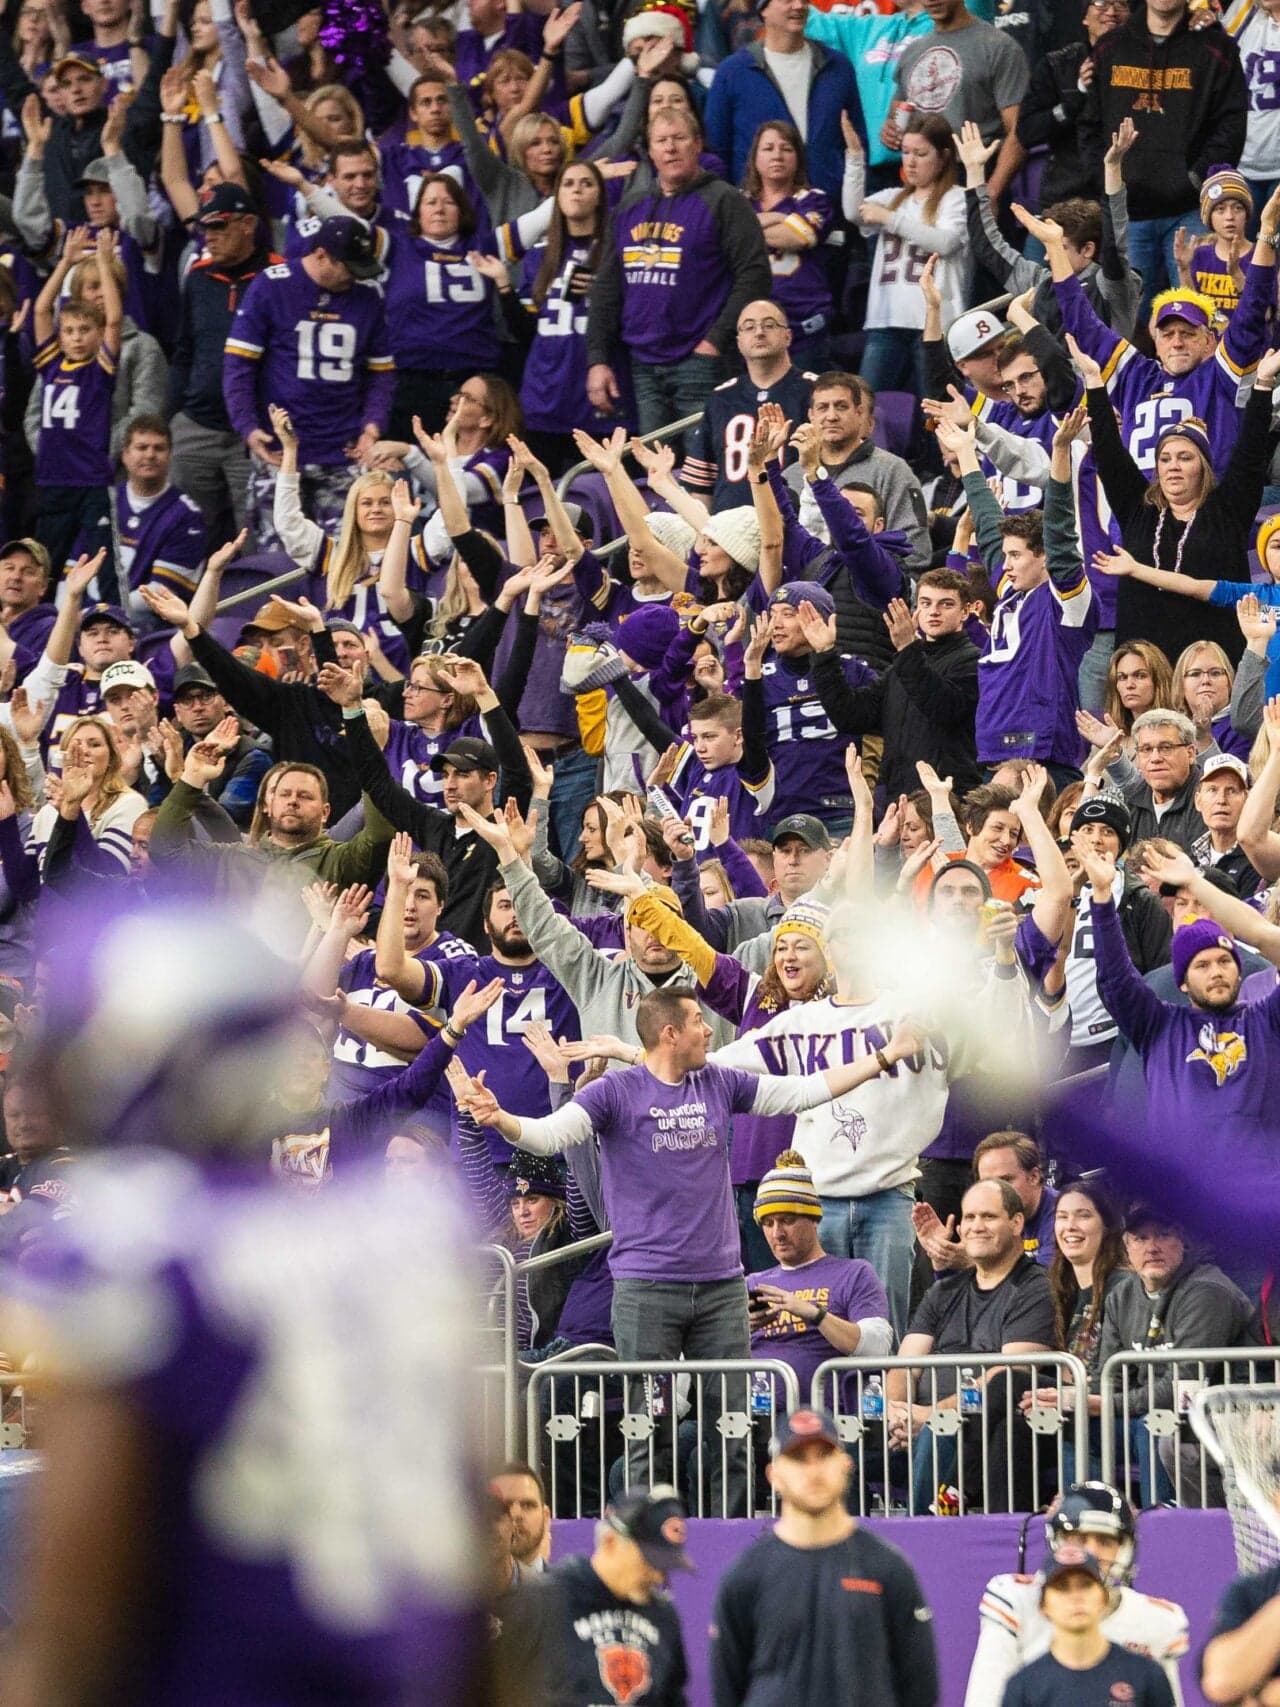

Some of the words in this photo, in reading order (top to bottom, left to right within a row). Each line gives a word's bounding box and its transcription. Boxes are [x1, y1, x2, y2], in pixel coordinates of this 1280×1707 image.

[424, 260, 487, 303] 15
[294, 320, 357, 382] 19
[43, 384, 81, 429] 14
[772, 701, 839, 742] 15
[487, 986, 553, 1046] 14
[652, 1127, 718, 1152] PURPLE
[658, 1118, 678, 1130] WE
